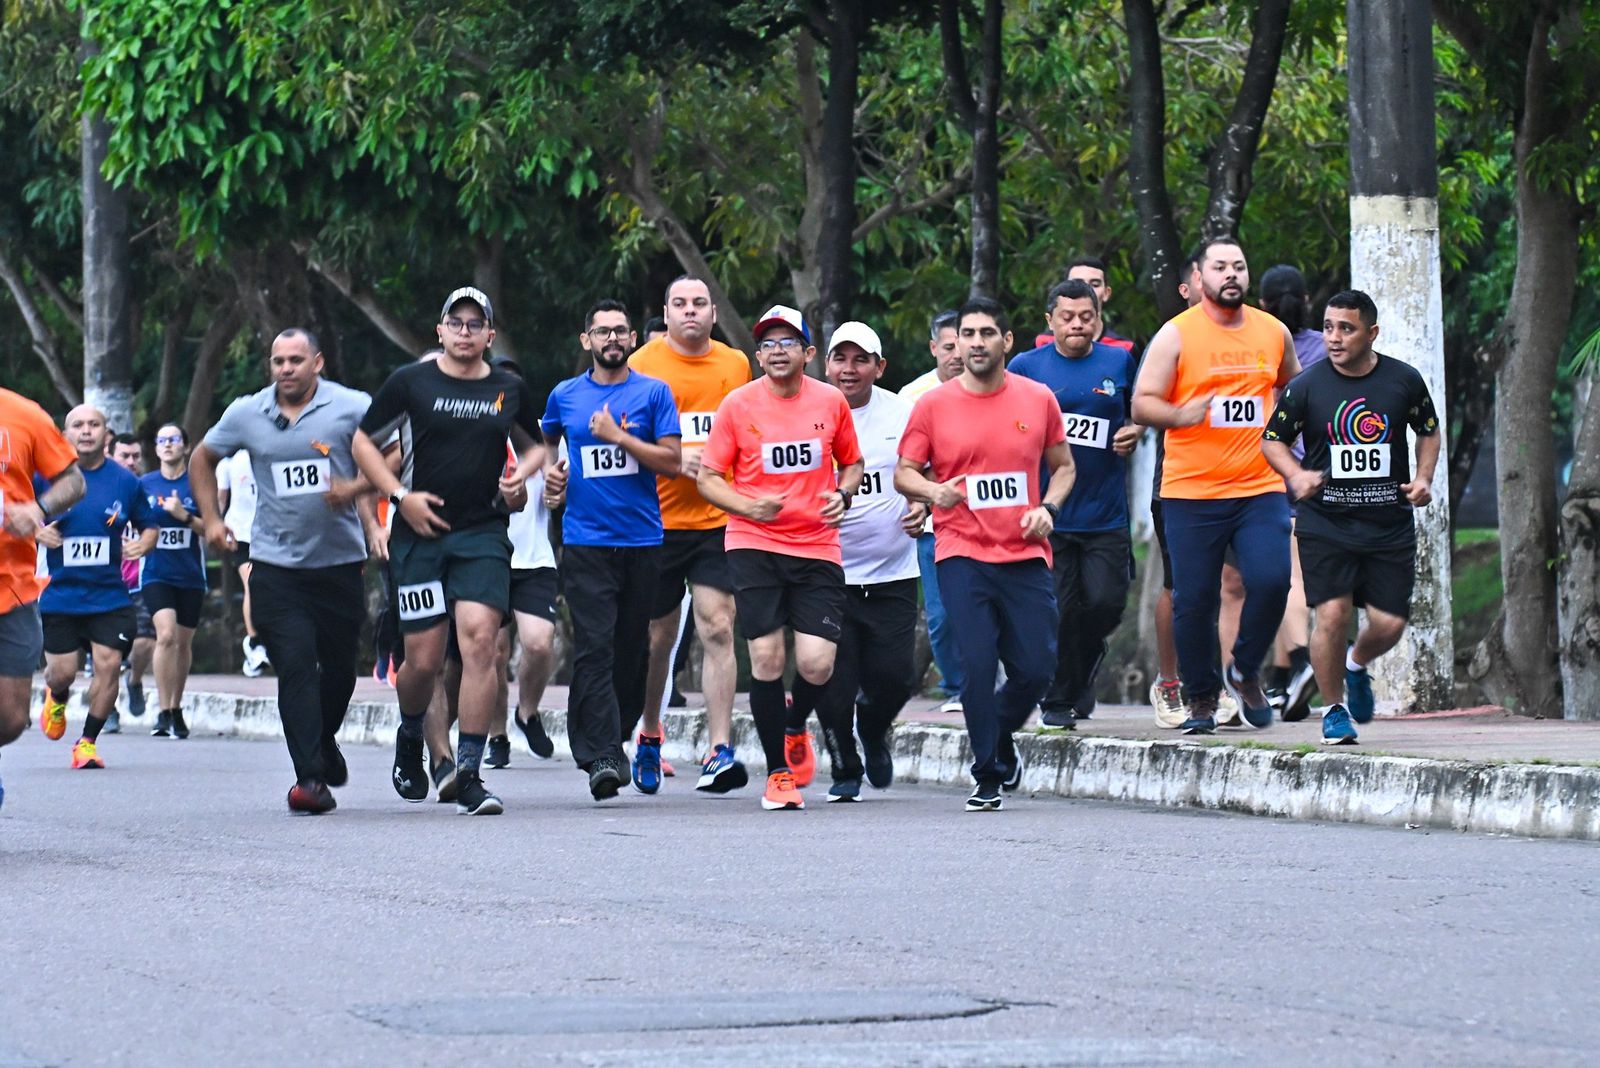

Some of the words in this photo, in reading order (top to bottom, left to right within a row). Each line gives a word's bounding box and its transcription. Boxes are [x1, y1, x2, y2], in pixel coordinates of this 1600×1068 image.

[432, 397, 500, 416] RUNNING
[1222, 399, 1255, 423] 120
[691, 415, 715, 436] 14
[1066, 417, 1099, 442] 221
[590, 447, 627, 471] 139
[772, 443, 812, 469] 005
[1340, 448, 1381, 473] 096
[282, 464, 319, 489] 138
[853, 471, 882, 496] 91
[976, 477, 1018, 502] 006
[160, 530, 185, 545] 284
[71, 541, 102, 560] 287
[399, 588, 435, 613] 300
